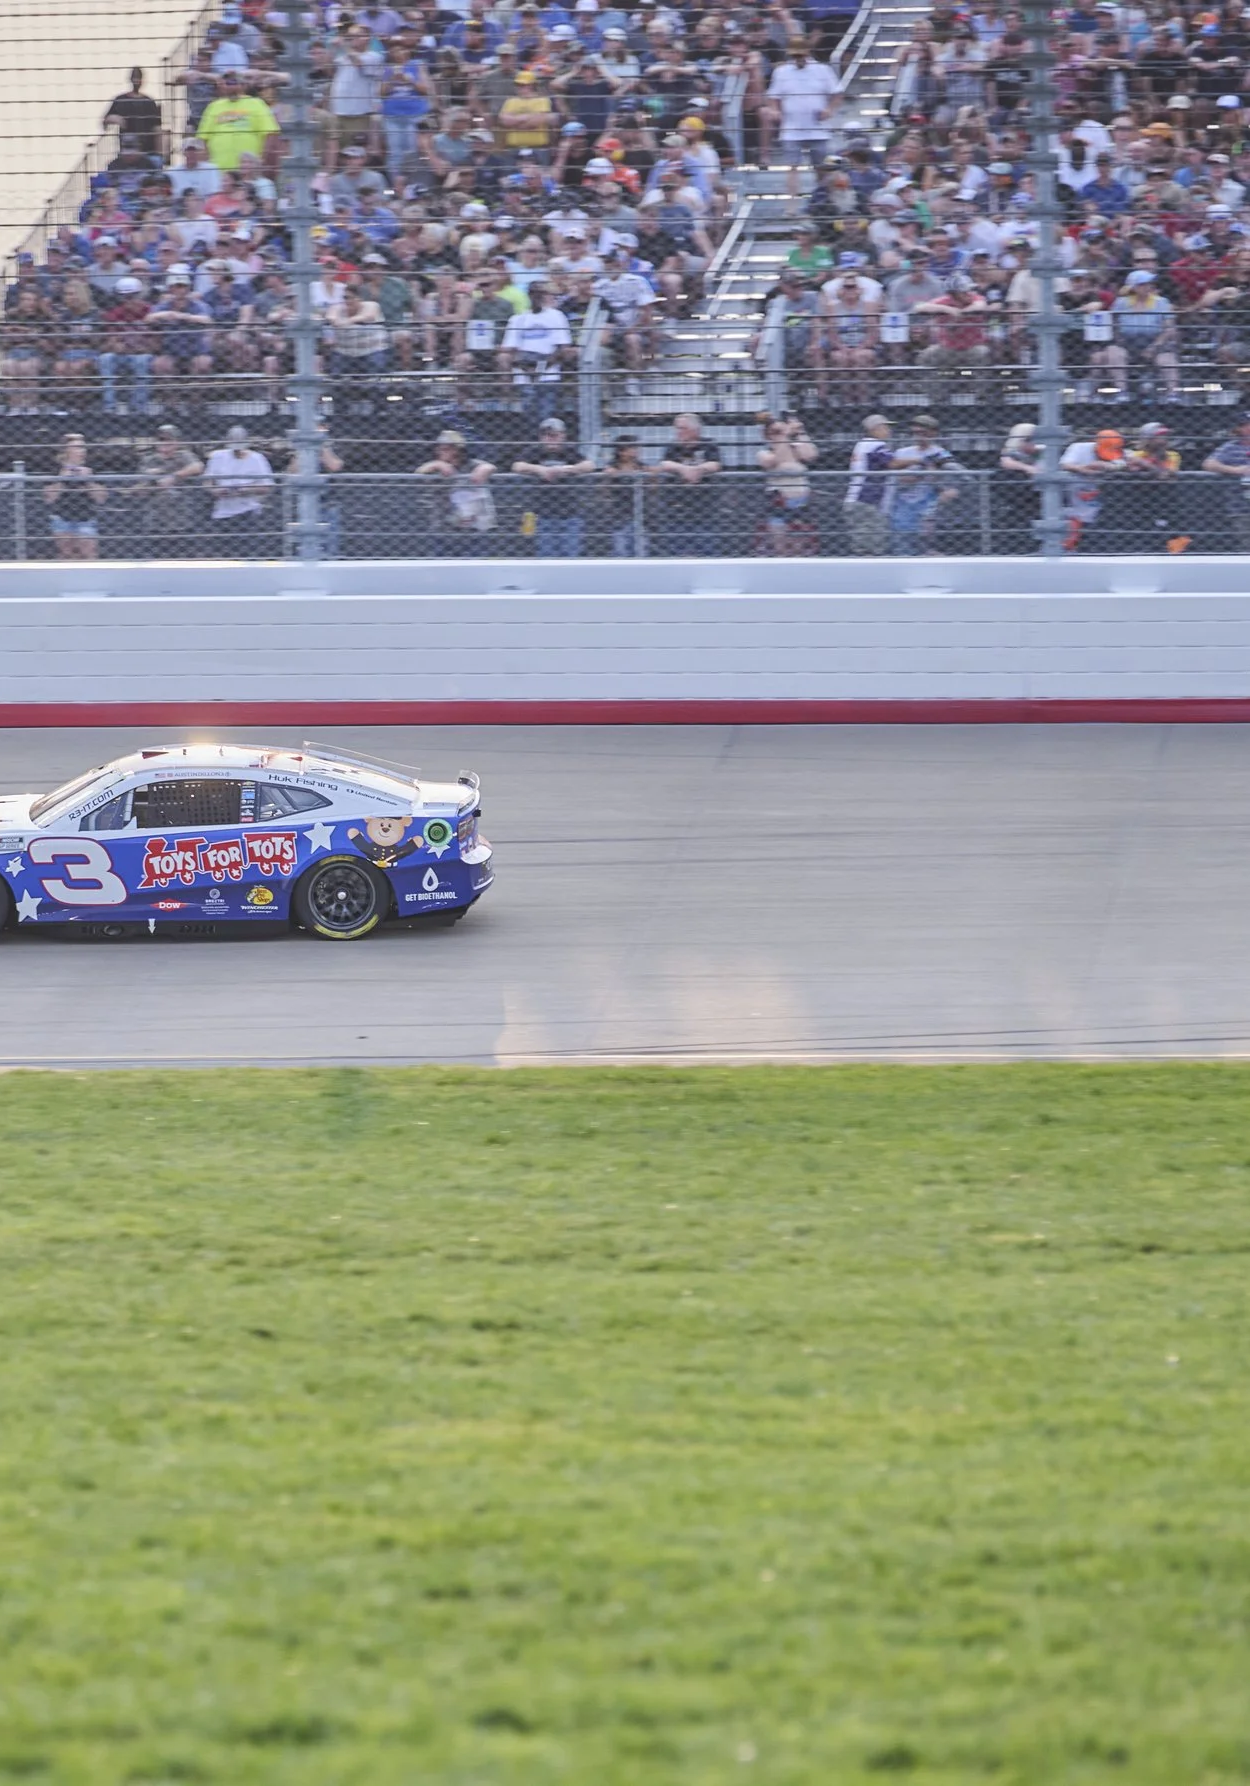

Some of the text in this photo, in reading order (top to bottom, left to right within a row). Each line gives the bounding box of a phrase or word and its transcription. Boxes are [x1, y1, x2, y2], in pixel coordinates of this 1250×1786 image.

[296, 777, 339, 792] Fishing
[149, 851, 197, 875] TOYS
[206, 846, 241, 868] FOR
[248, 836, 294, 861] TOTS
[28, 837, 128, 906] 3
[405, 893, 417, 902] GET
